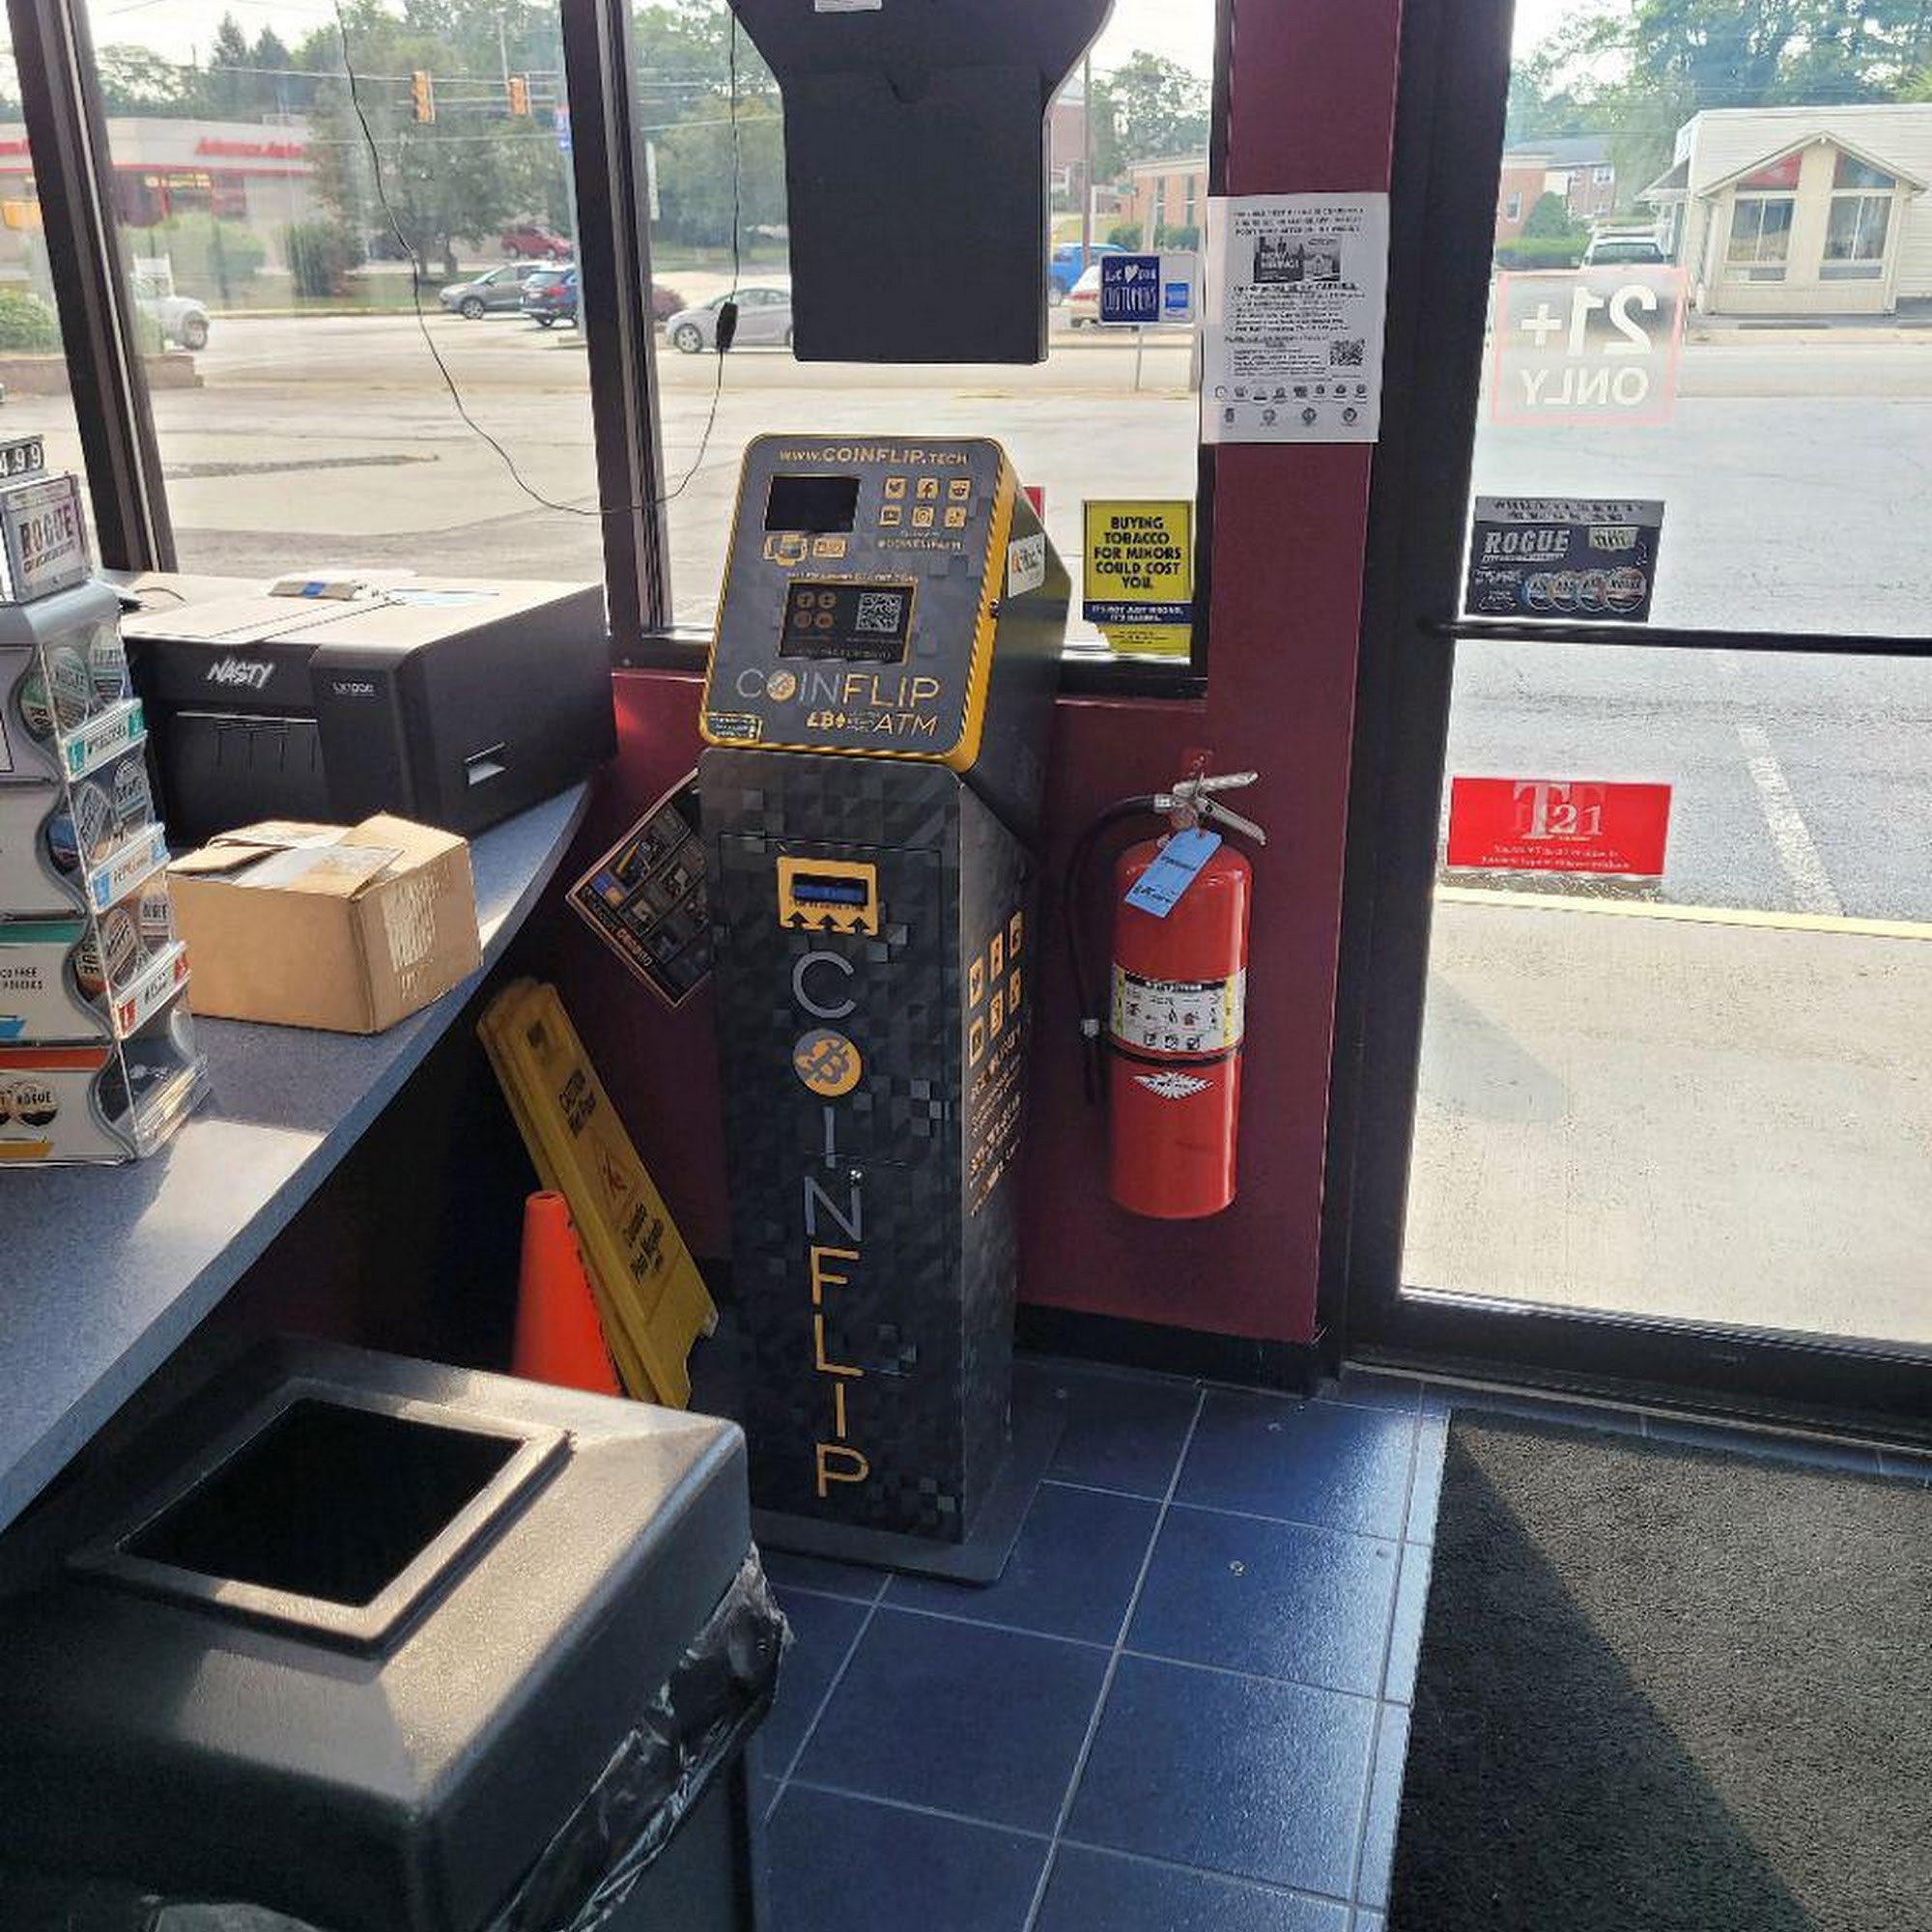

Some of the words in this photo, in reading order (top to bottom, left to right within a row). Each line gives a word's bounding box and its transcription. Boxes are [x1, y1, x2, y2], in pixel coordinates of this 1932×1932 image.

[1110, 516, 1164, 529] BUYING
[1103, 532, 1170, 545] TOBACCO
[1484, 529, 1571, 554] ROGUE
[1094, 546, 1122, 559] FOR
[1126, 546, 1181, 559] MINORS
[1095, 561, 1141, 575] COULD
[1145, 562, 1180, 576] COST
[206, 656, 274, 689] NASTY
[736, 668, 940, 709] COINFLIP
[872, 713, 938, 737] ATM
